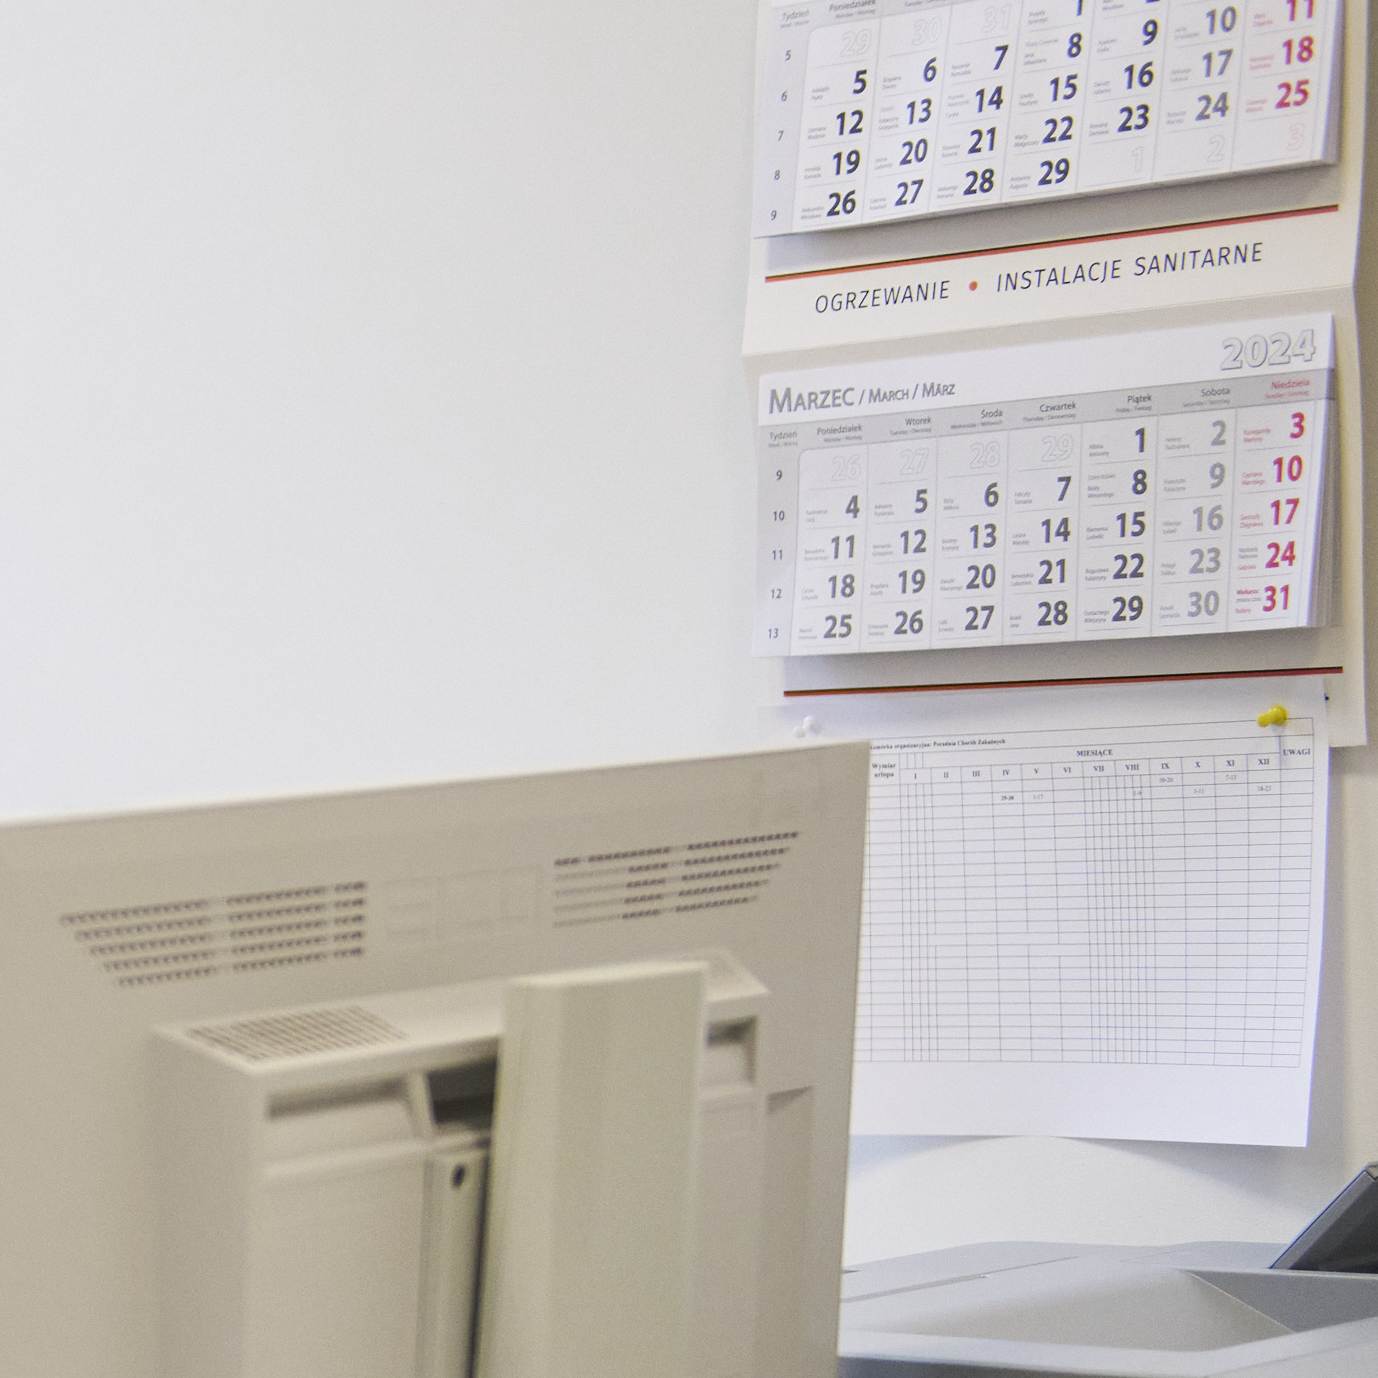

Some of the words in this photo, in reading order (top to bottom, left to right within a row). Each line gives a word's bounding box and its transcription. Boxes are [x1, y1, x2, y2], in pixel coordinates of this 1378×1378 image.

[781, 91, 787, 101] 6
[853, 69, 867, 94] 5
[924, 57, 937, 82] 6
[994, 44, 1009, 70] 7
[1067, 32, 1083, 58] 8
[1143, 19, 1159, 45] 9
[1206, 6, 1238, 34] 10
[786, 50, 791, 61] 5
[778, 130, 784, 141] 7
[837, 110, 864, 135] 12
[907, 98, 932, 125] 13
[976, 86, 1004, 112] 14
[1050, 74, 1078, 101] 15
[1125, 61, 1154, 89] 16
[1203, 48, 1234, 77] 17
[1283, 35, 1315, 64] 18
[774, 170, 780, 180] 8
[833, 150, 861, 175] 19
[900, 138, 928, 165] 20
[968, 127, 996, 154] 21
[1043, 116, 1074, 143] 22
[1118, 104, 1150, 132] 23
[1196, 92, 1230, 121] 24
[1276, 79, 1310, 109] 25
[771, 210, 777, 220] 9
[827, 190, 856, 216] 26
[895, 179, 924, 206] 27
[963, 168, 995, 195] 28
[1038, 158, 1070, 185] 29
[815, 280, 950, 313] OGRZEWANIE
[996, 259, 1121, 293] INSTALACJE
[1134, 242, 1263, 277] SANITARNE
[1221, 329, 1316, 370] 2024
[905, 416, 932, 426] Wtorek
[981, 408, 1003, 419] Środa
[1039, 401, 1077, 413] Czwartek
[1127, 393, 1152, 404] Piątek
[1200, 386, 1231, 398] Sobota
[1271, 379, 1310, 390] Niedziela
[776, 470, 782, 480] 9
[1135, 428, 1146, 452] 1
[1211, 420, 1227, 446] 2
[1290, 412, 1305, 439] 3
[774, 511, 785, 521] 10
[846, 495, 860, 518] 4
[915, 489, 928, 513] 5
[985, 482, 999, 507] 6
[1058, 476, 1072, 501] 7
[1132, 469, 1148, 495] 8
[1209, 462, 1226, 489] 9
[1273, 455, 1303, 482] 10
[773, 550, 782, 560] 11
[832, 535, 855, 559] 11
[901, 529, 927, 554] 12
[970, 523, 997, 548] 13
[1042, 517, 1071, 543] 14
[1117, 511, 1146, 537] 15
[1193, 505, 1224, 532] 16
[1271, 498, 1300, 525] 17
[772, 589, 781, 599] 12
[829, 574, 855, 598] 18
[899, 569, 926, 594] 19
[966, 564, 996, 589] 20
[1038, 559, 1066, 584] 21
[1113, 553, 1144, 579] 22
[1189, 547, 1221, 574] 23
[1266, 541, 1296, 568] 24
[769, 628, 778, 638] 13
[824, 614, 852, 638] 25
[894, 610, 924, 635] 26
[965, 605, 994, 630] 27
[1038, 600, 1068, 626] 28
[1112, 596, 1144, 622] 29
[1188, 591, 1220, 617] 30
[1263, 585, 1289, 612] 31
[1076, 748, 1114, 759] MIESIĄCE
[1125, 763, 1140, 771] VIII
[1282, 748, 1311, 756] UWAGI
